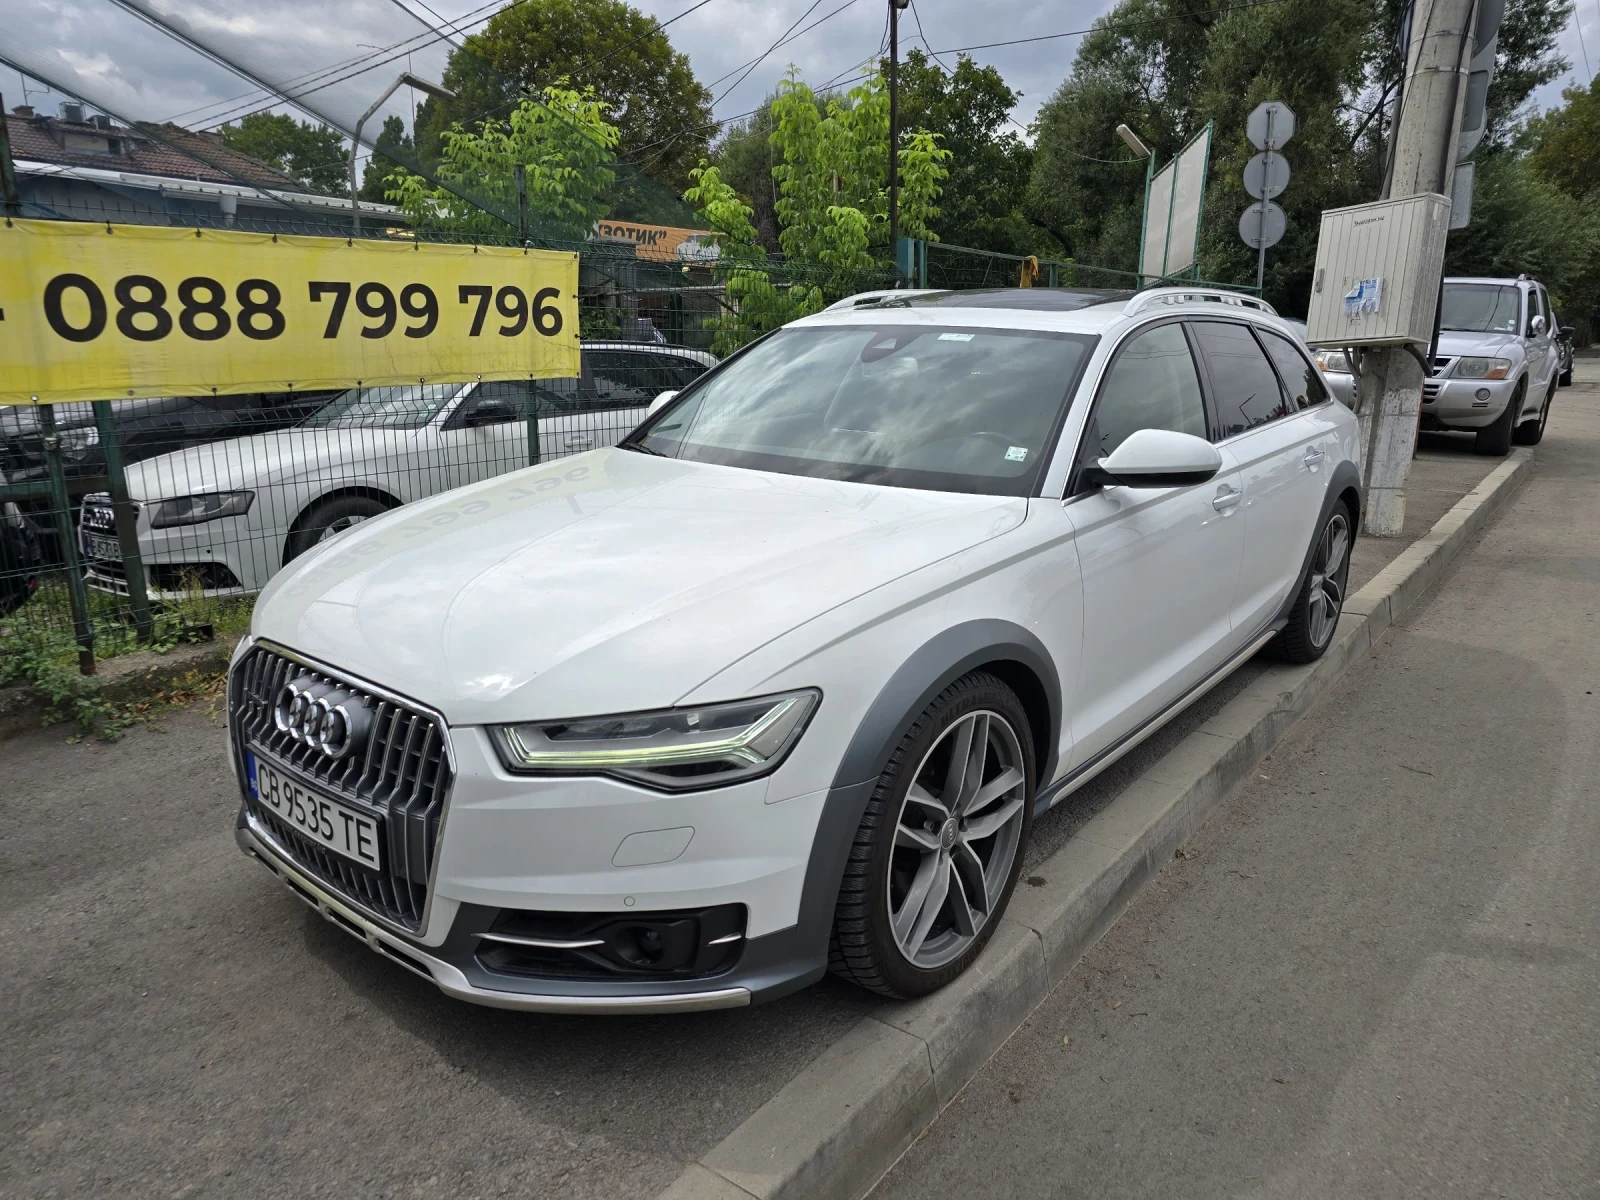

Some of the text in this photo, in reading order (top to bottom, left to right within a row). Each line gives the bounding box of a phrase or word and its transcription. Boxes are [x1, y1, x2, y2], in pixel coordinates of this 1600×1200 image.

[598, 225, 667, 246] ЗОТИК”
[43, 272, 563, 342] 0888 799 796
[257, 763, 281, 808] CB
[283, 781, 334, 841] 9535
[338, 809, 375, 862] TE
